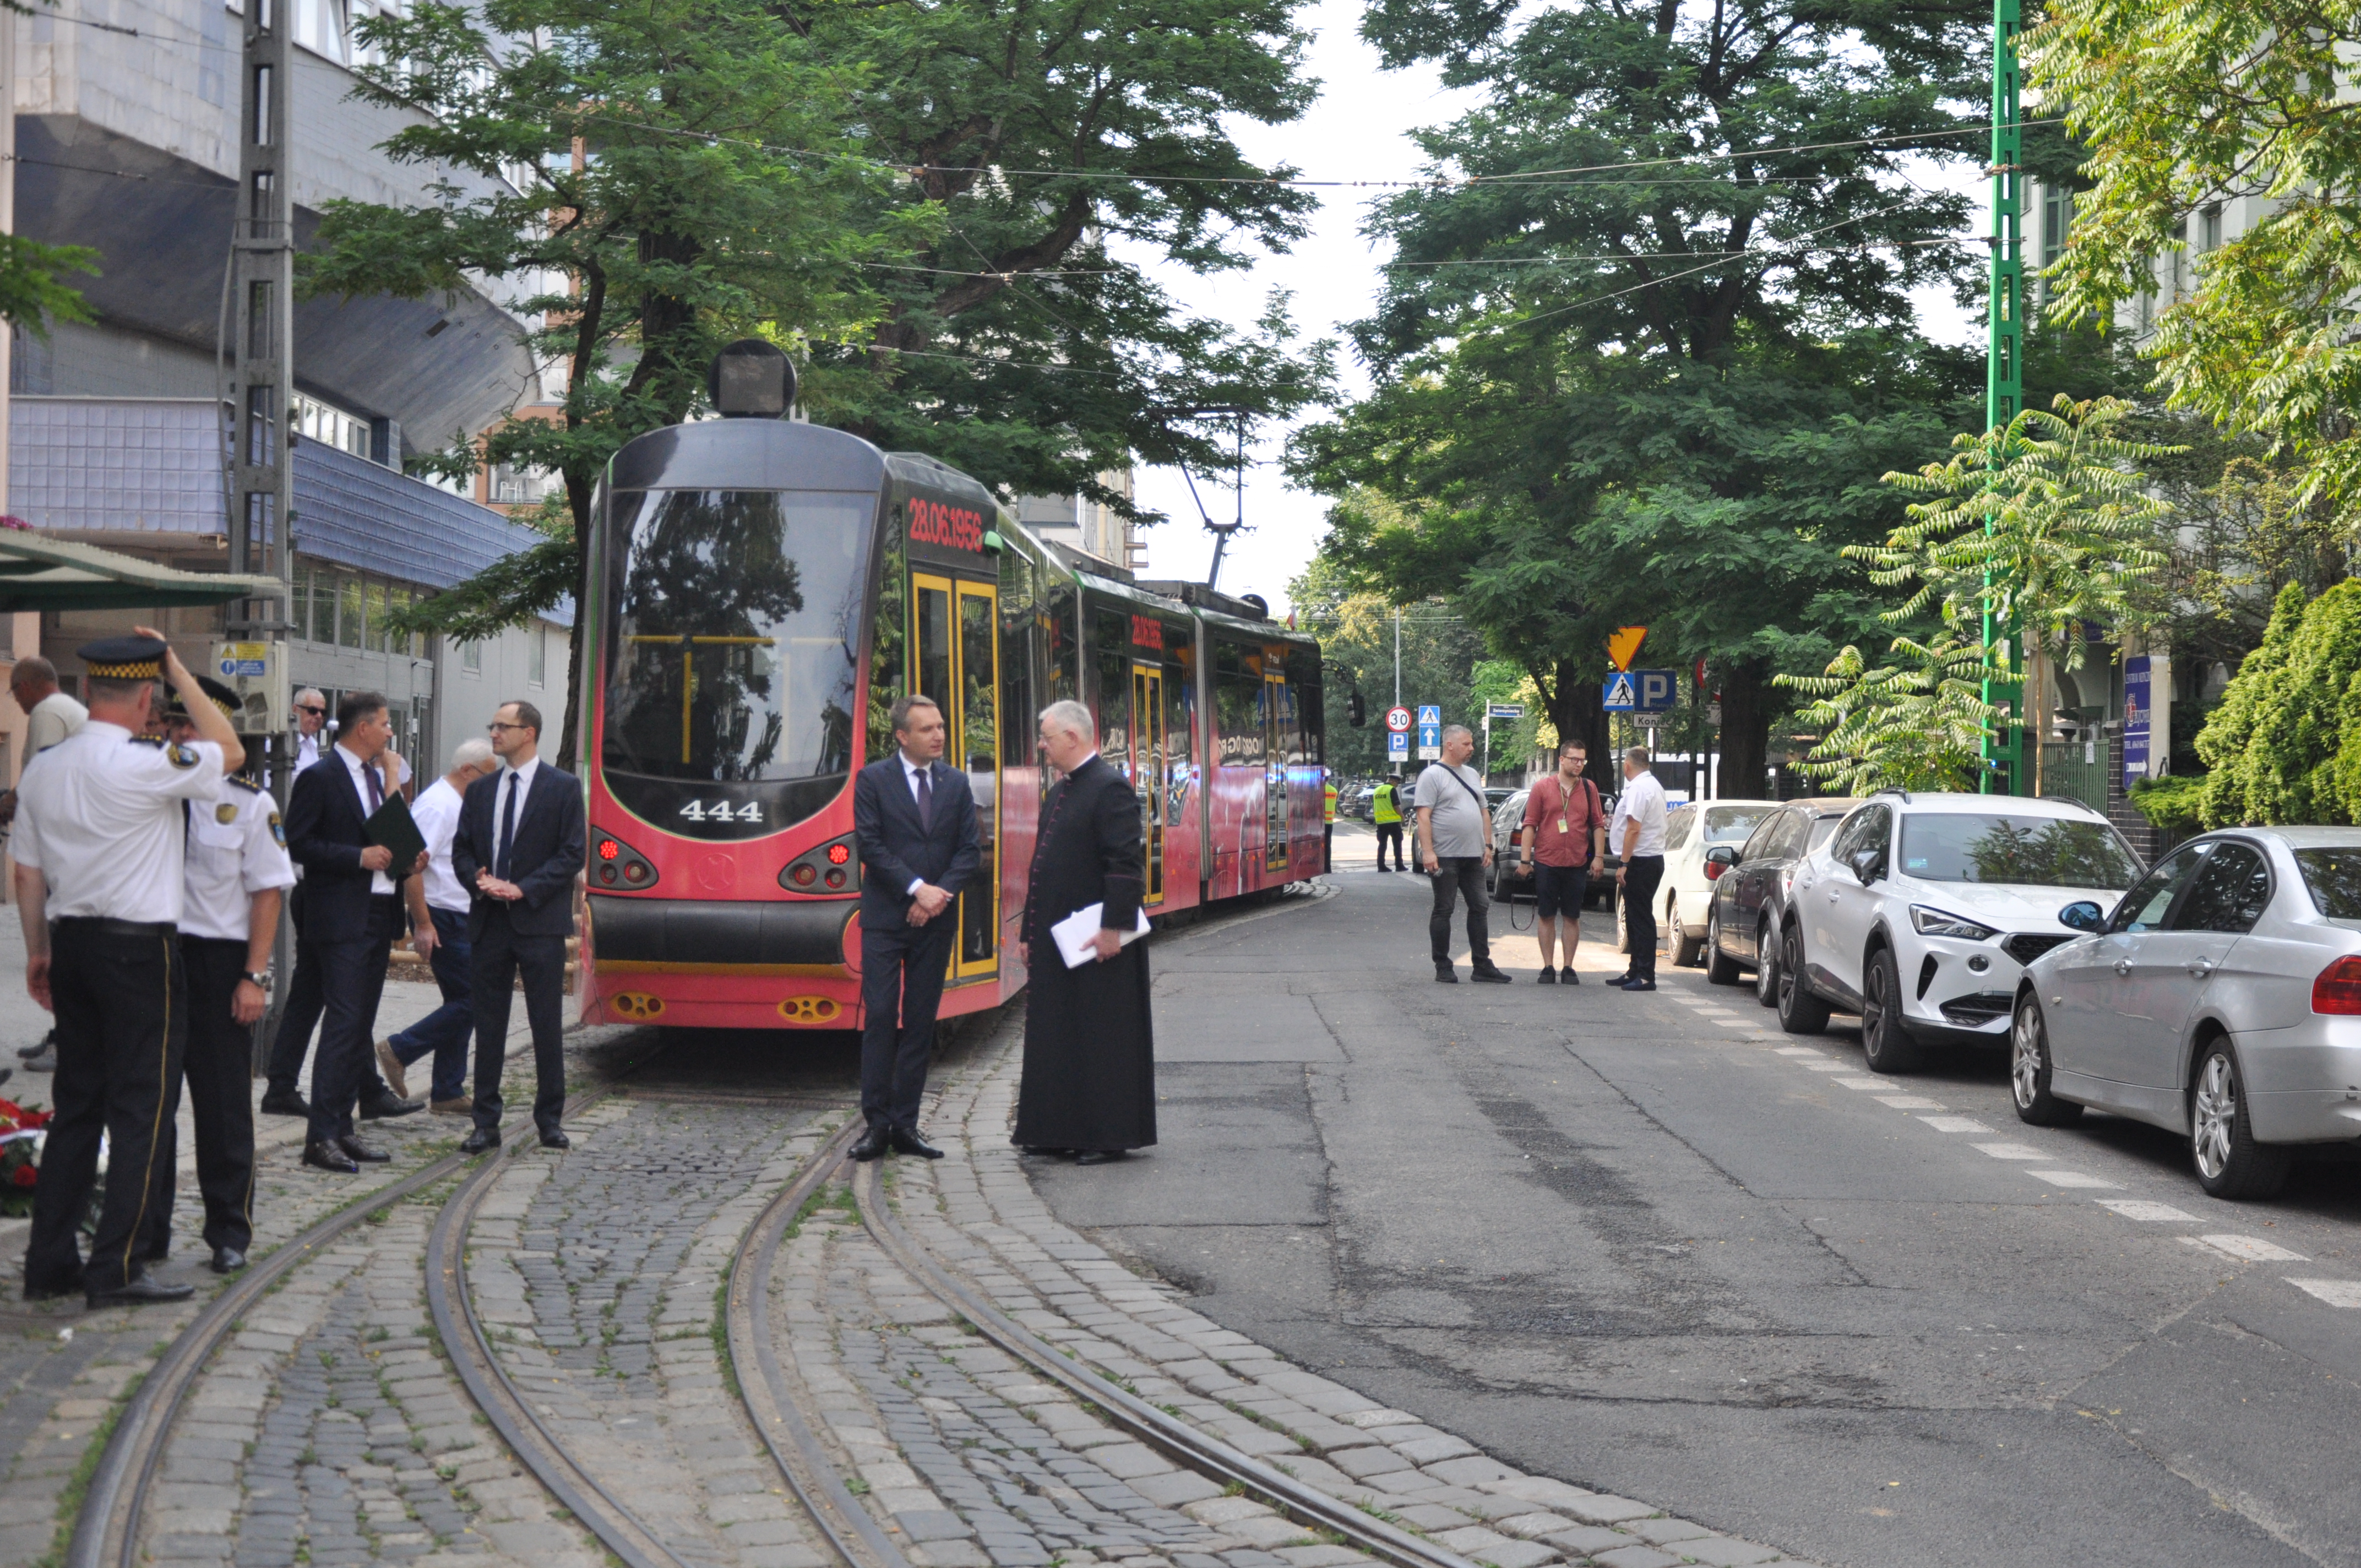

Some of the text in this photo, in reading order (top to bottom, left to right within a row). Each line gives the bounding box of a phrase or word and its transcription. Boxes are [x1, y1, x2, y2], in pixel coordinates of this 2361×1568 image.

[909, 497, 983, 552] 28.06.1956
[1644, 674, 1667, 707] P
[1390, 714, 1408, 726] 30
[1393, 734, 1405, 750] P
[679, 800, 763, 822] 444
